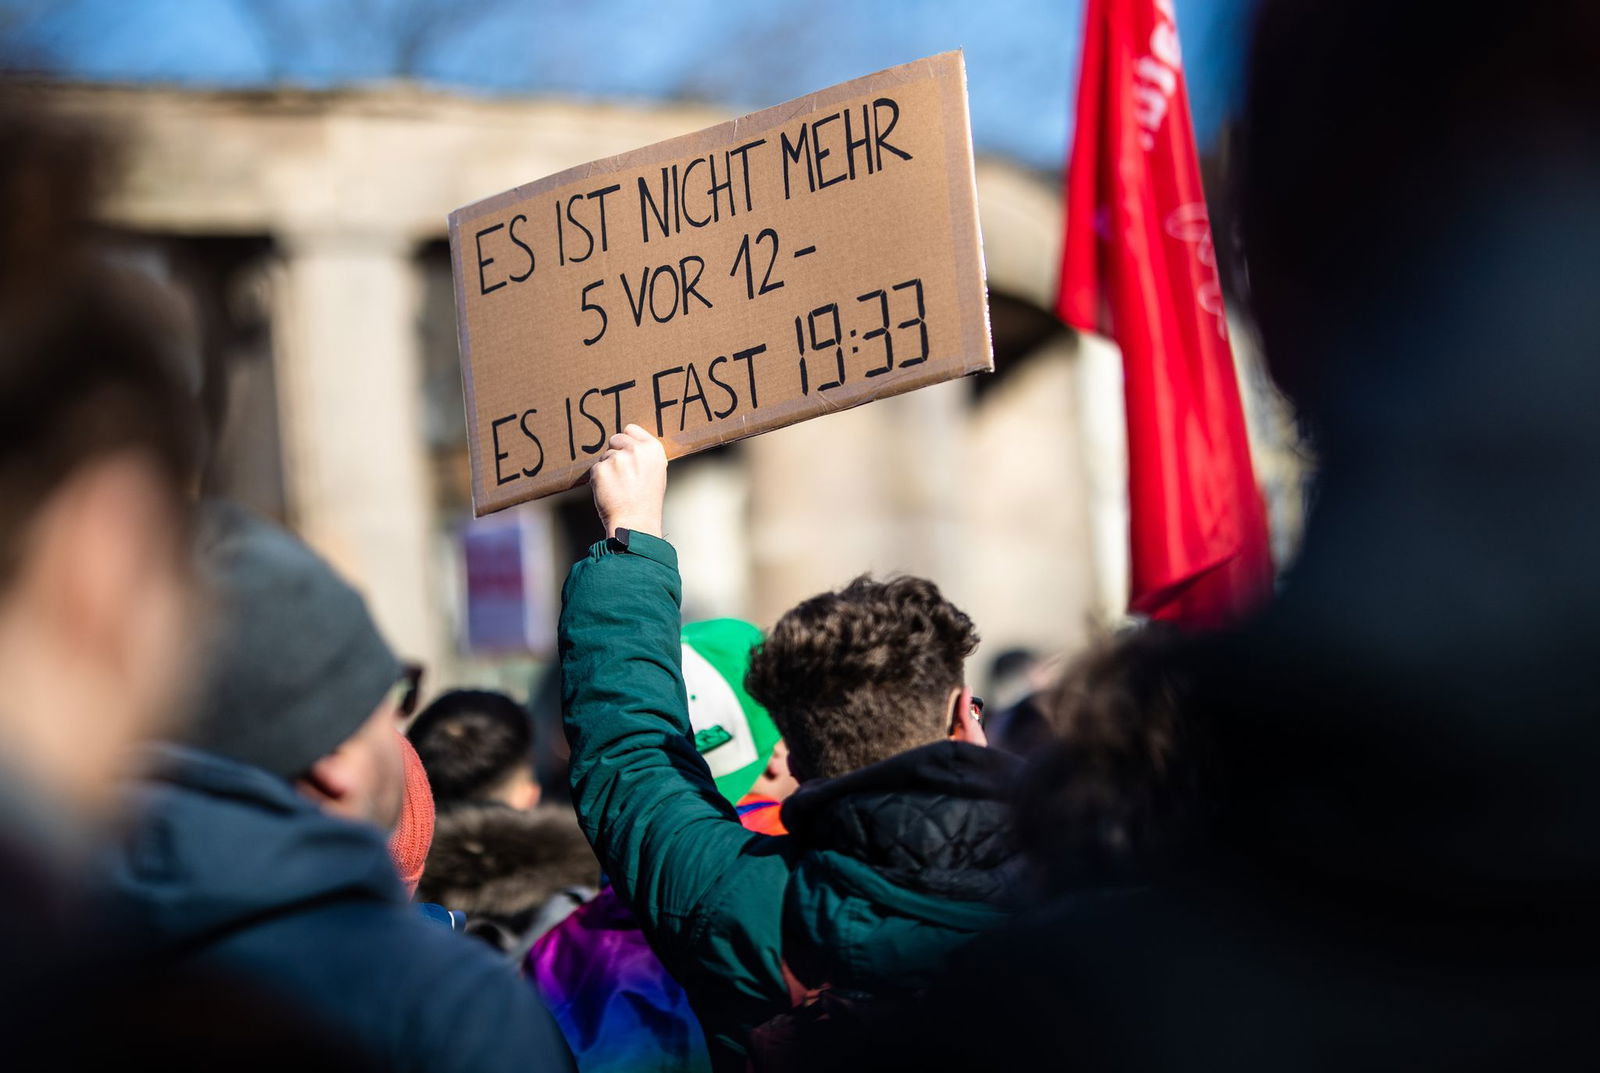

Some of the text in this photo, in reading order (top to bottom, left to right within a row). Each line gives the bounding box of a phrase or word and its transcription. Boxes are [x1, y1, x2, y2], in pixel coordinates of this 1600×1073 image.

[476, 98, 912, 295] ES IST NICHT MEHR
[492, 279, 929, 485] ES IST FAST 19:33
[582, 280, 607, 345] 5
[620, 256, 712, 327] VOR
